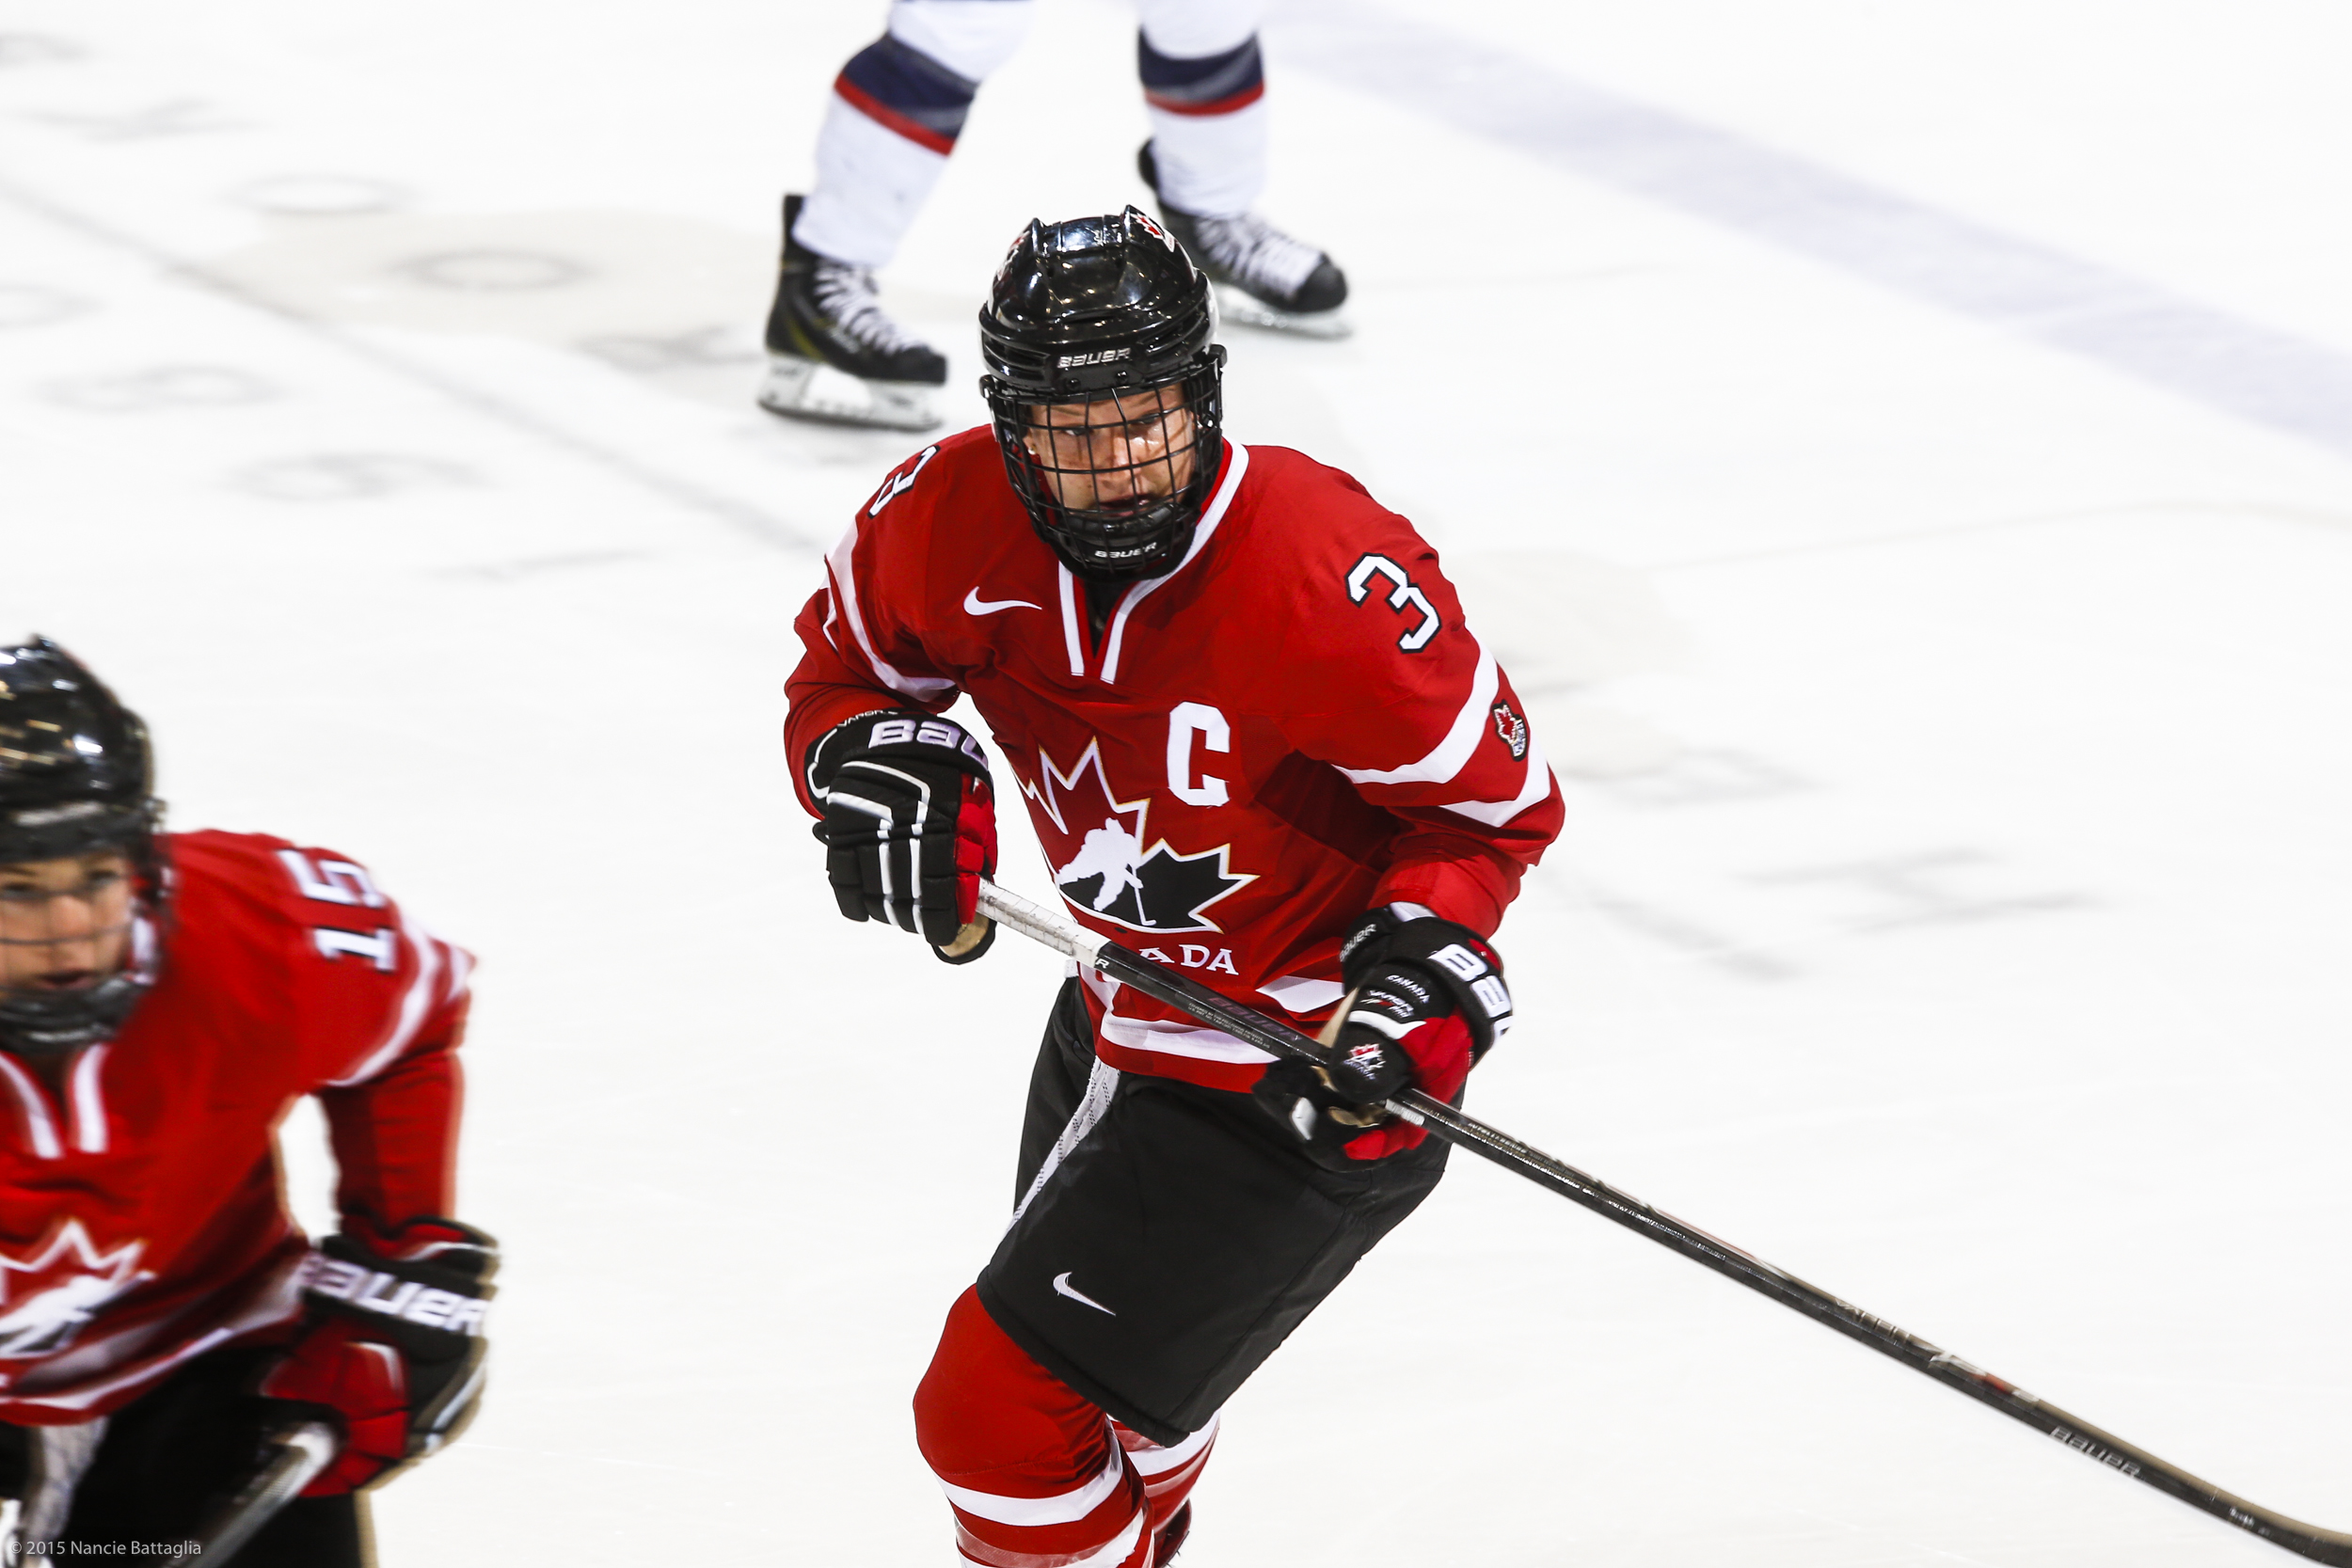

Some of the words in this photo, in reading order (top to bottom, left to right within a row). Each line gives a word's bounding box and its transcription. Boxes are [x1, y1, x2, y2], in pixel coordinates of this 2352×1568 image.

[1057, 347, 1131, 368] BAUER
[1094, 542, 1157, 559] BAUER
[1345, 552, 1441, 654] 3
[1168, 701, 1230, 806] C
[278, 847, 396, 973] 15
[1384, 974, 1430, 1004] CANADA
[1206, 997, 1303, 1042] BAUER
[2050, 1425, 2141, 1478] BAUER
